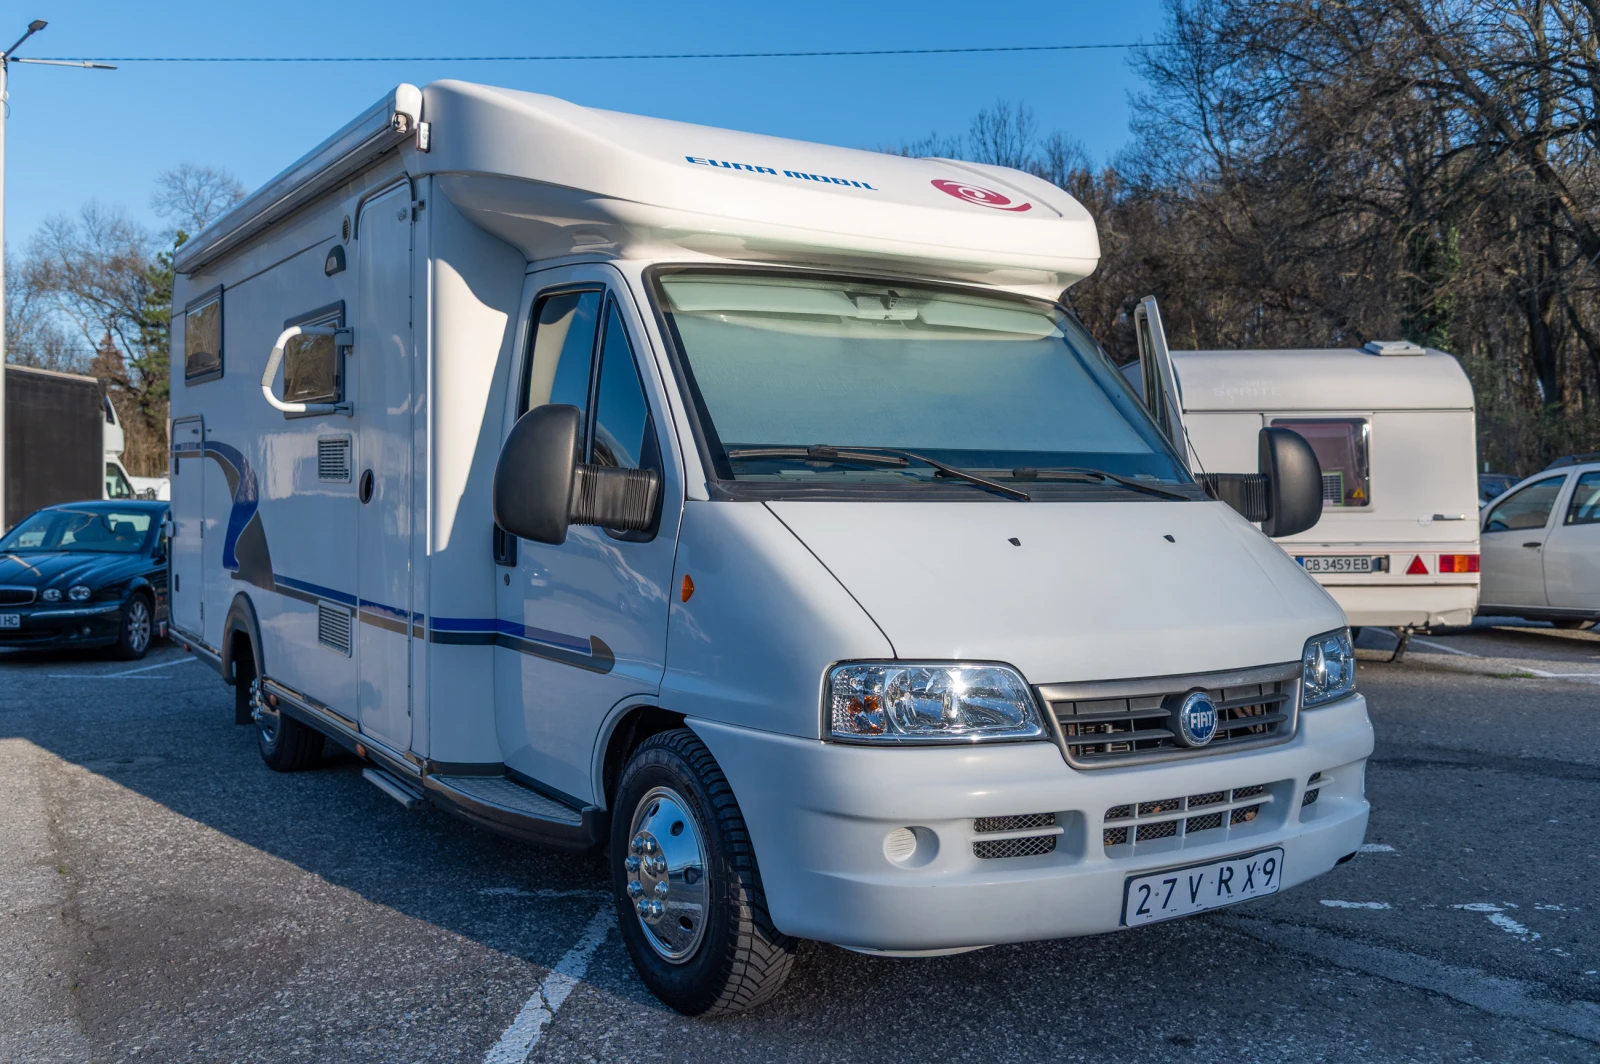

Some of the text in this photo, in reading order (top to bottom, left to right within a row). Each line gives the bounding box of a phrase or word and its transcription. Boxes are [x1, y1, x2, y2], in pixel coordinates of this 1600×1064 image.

[685, 156, 879, 191] EURA MOBIL
[1212, 387, 1281, 396] SPRITE
[1305, 558, 1369, 571] CB 3459 EB
[1190, 710, 1213, 729] FIAT
